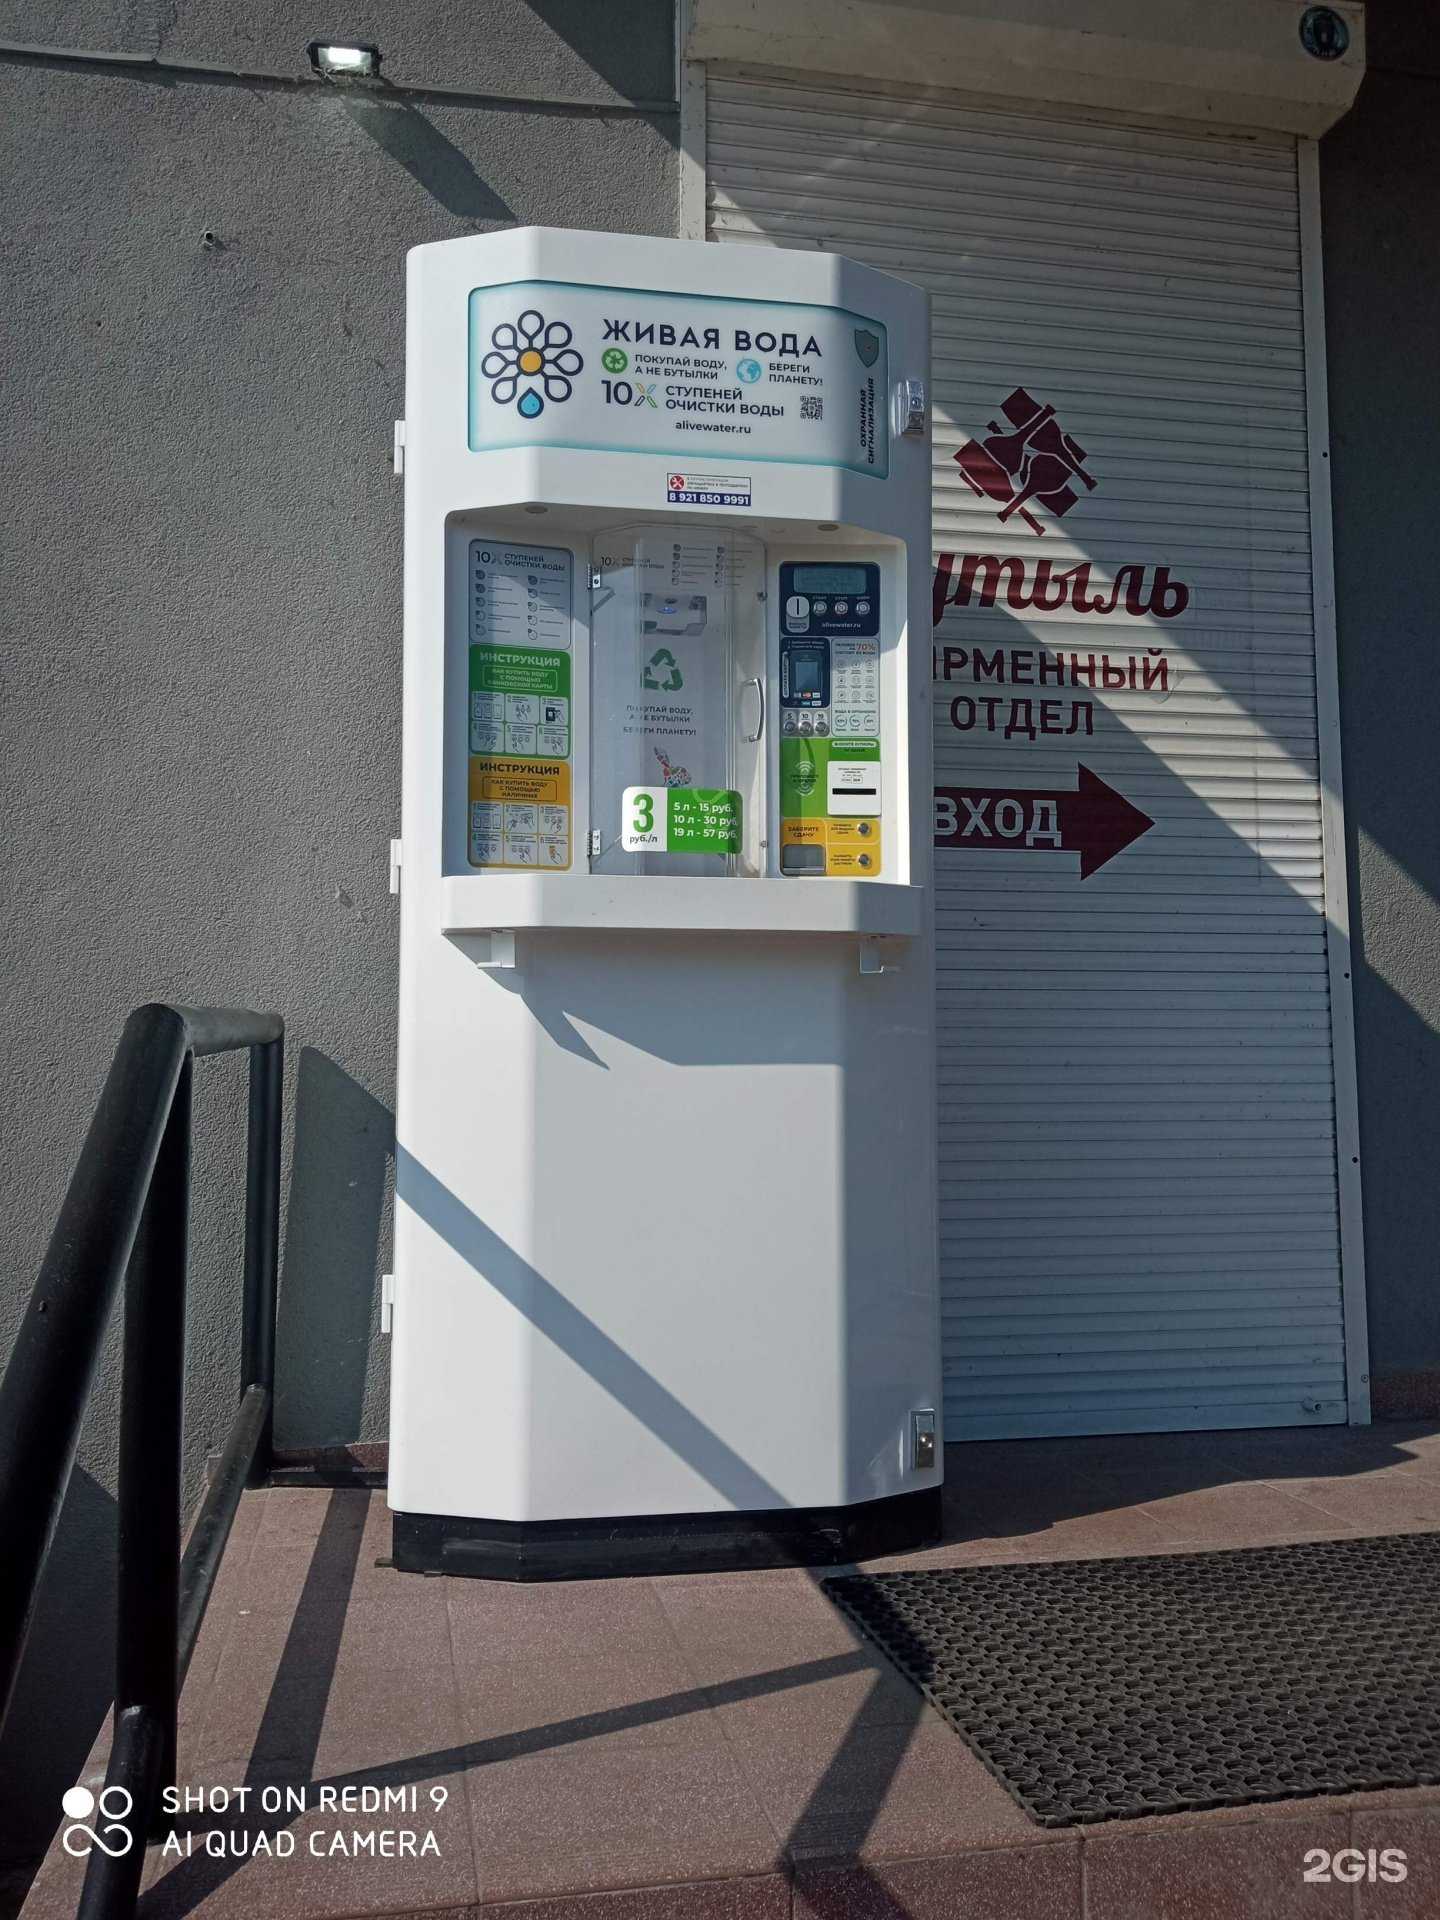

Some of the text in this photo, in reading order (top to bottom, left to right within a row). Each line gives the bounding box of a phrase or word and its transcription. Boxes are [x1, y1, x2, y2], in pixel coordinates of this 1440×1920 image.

[602, 318, 822, 358] ЖИВАЯ ВОДА
[635, 354, 727, 370] ПОКУПАЙ ВОДУ,
[769, 362, 810, 373] БЕРЕГИ
[635, 366, 718, 380] А НЕ БУТЫЛКИ
[769, 374, 823, 386] ПЛАНЕТУ!
[665, 385, 743, 400] СТУПЕНЕЙ
[665, 399, 784, 417] ОЧИСТКИ ВОДЫ
[675, 420, 751, 434] alivewater.ru
[669, 492, 749, 505] 8 921 850 9991
[480, 653, 560, 667] ИНСТРУКЦИЯ
[933, 646, 1168, 691] РМЕННЫЙ
[951, 696, 1093, 740] ОТДЕЛ
[480, 762, 560, 775] ИНСТРУКЦИЯ
[633, 793, 654, 833] 3
[673, 802, 680, 811] 5
[699, 802, 709, 811] 15
[711, 803, 733, 814] руб.
[673, 815, 685, 823] 10
[703, 815, 717, 824] 30
[934, 796, 1062, 847] ВХОД
[629, 834, 658, 844] руб./л
[673, 827, 684, 837] 19
[703, 828, 715, 837] 57
